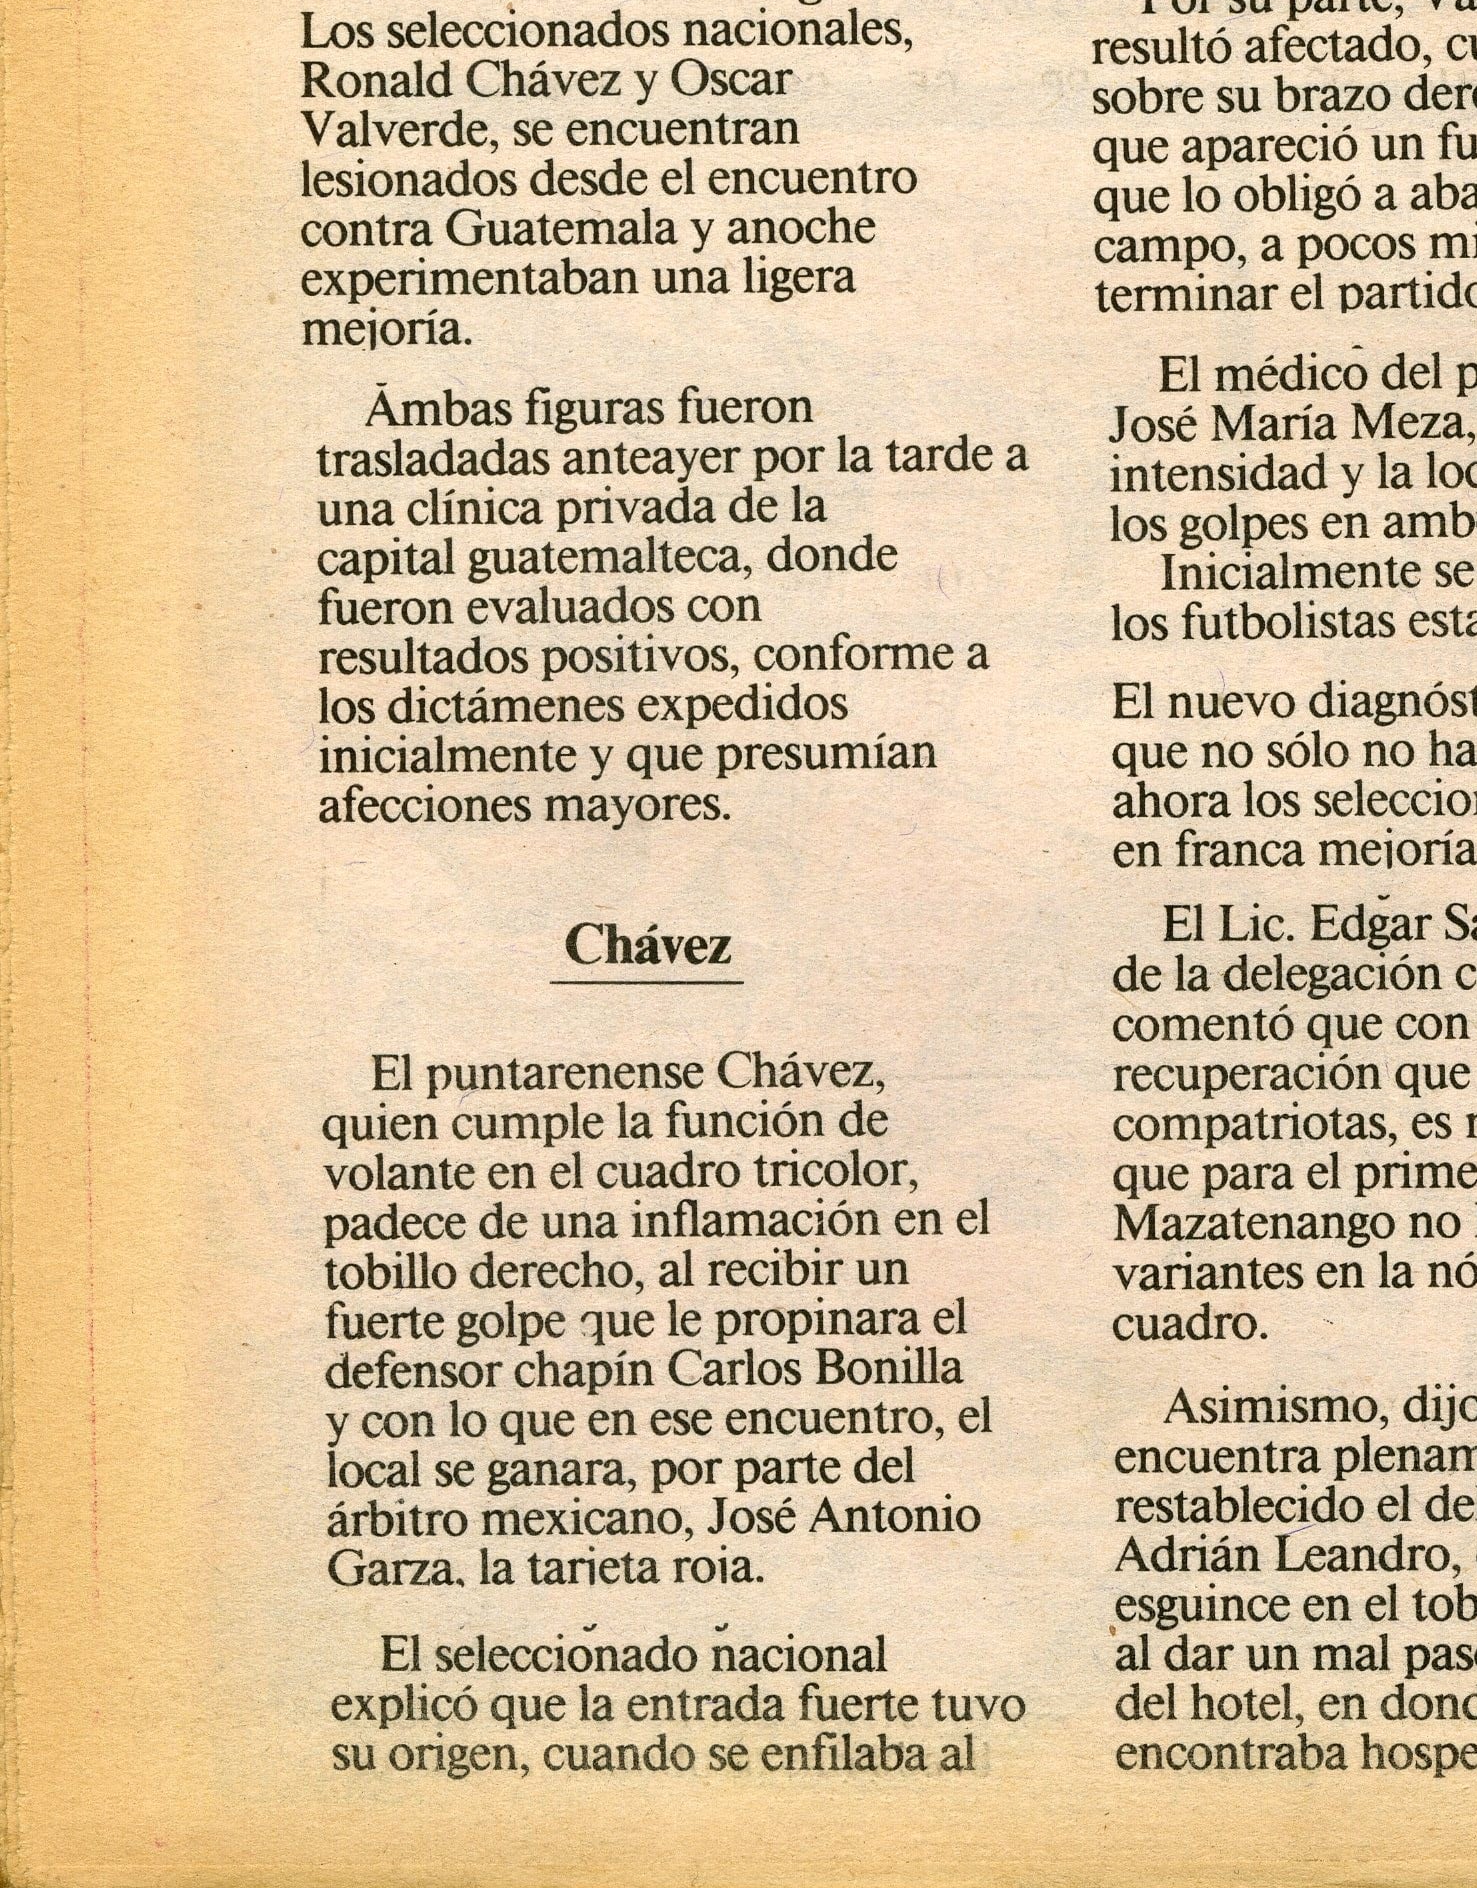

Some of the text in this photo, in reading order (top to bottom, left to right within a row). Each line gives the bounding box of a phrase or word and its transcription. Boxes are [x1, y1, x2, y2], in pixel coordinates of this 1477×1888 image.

[301, 206, 875, 253] contra Guatemala y anoche
[1109, 406, 1197, 443] José
[1212, 404, 1337, 441] María
[1351, 403, 1475, 444] Meza,
[1114, 682, 1154, 718] El
[1169, 692, 1295, 718] nuevo
[566, 923, 731, 965] Chávez
[1164, 904, 1203, 941] El
[1220, 904, 1293, 941] Lic.
[1312, 904, 1432, 950] Edgar
[372, 1051, 884, 1099] El puntarenense Chávez,
[1114, 1204, 1395, 1248] Mazatenango
[1409, 1212, 1460, 1238] no
[1115, 1535, 1260, 1572] Adrián
[1275, 1534, 1460, 1578] Leandro,
[333, 1732, 974, 1779] su origen, cuando se enfilaba al
